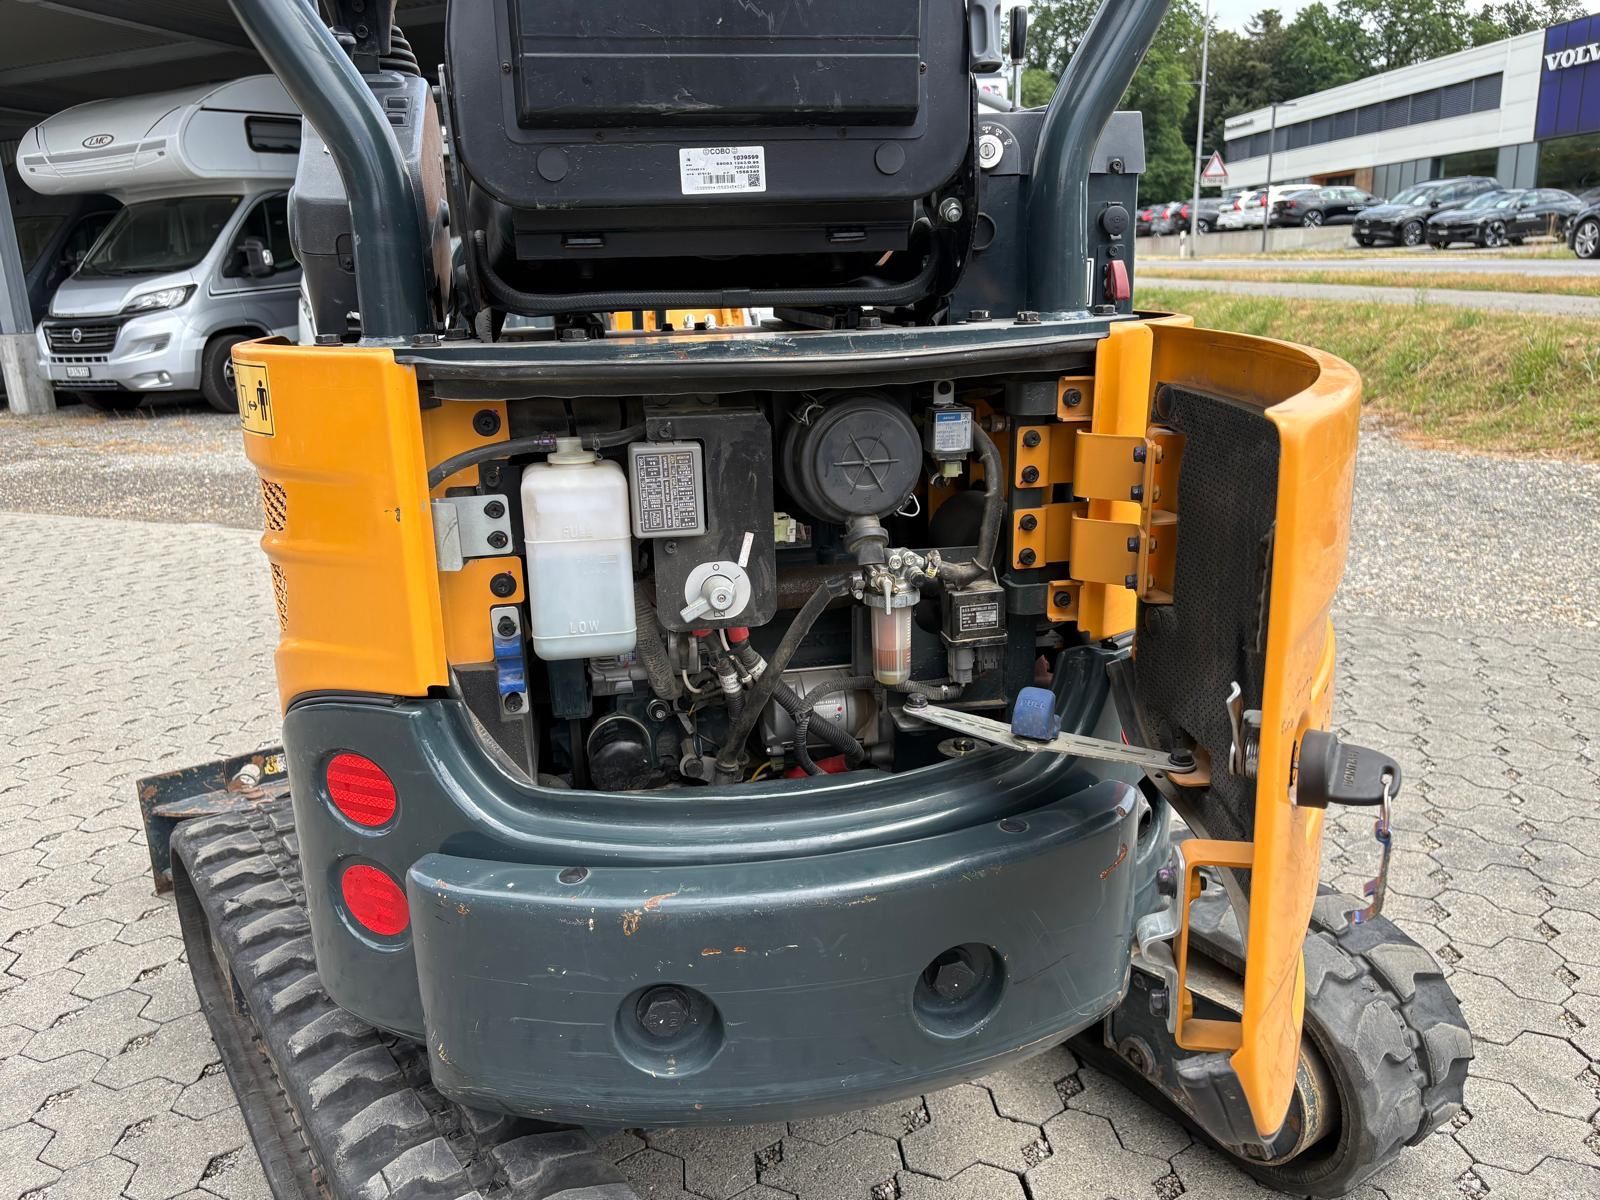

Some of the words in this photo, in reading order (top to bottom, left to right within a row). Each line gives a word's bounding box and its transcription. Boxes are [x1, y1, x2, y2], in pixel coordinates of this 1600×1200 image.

[1544, 43, 1600, 71] VOLV
[89, 136, 109, 145] LMC
[569, 619, 600, 634] LOW
